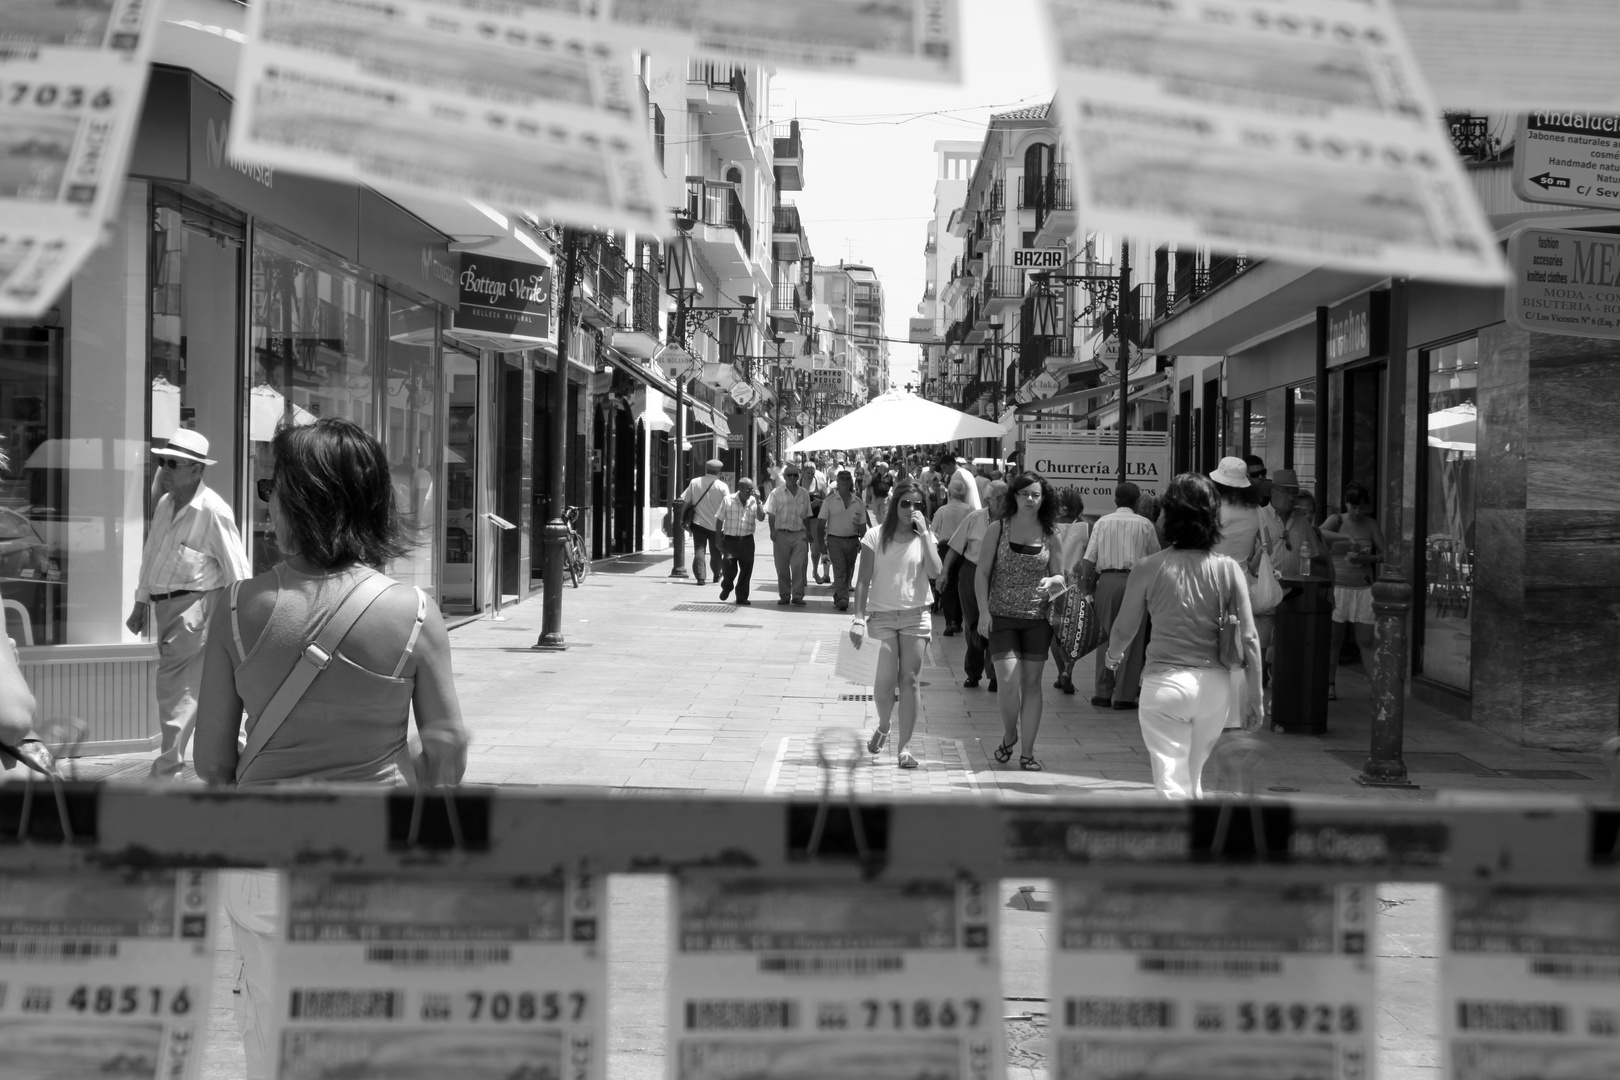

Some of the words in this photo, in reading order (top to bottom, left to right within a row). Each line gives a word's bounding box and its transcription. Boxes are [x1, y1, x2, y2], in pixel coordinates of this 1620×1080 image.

[0, 81, 112, 113] 7036
[1534, 110, 1620, 132] Andaluci
[1528, 131, 1565, 142] Jabones
[1567, 136, 1610, 147] naturales
[1549, 157, 1597, 169] Handmade
[1577, 185, 1592, 196] C/
[1539, 236, 1559, 249] fashion
[1014, 251, 1061, 266] BAZAR
[460, 264, 506, 304] Bottega
[509, 275, 547, 302] Verde
[1527, 270, 1546, 283] knitted
[1547, 271, 1567, 284] clothes
[1544, 287, 1584, 300] MODA
[1523, 297, 1592, 312] BISUTERIA
[473, 309, 500, 318] BELLEZA
[505, 314, 532, 323] NATURAL
[1525, 311, 1536, 320] C/
[1537, 312, 1549, 320] Los
[1551, 314, 1580, 324] Vicentes
[1329, 310, 1367, 358] trechos
[1035, 459, 1110, 475] Churrería
[1114, 462, 1158, 476] LBA
[1093, 487, 1111, 495] con
[1074, 601, 1085, 651] encuentro
[67, 984, 192, 1016] 48516
[467, 991, 589, 1022] 70857
[861, 998, 983, 1029] 71867
